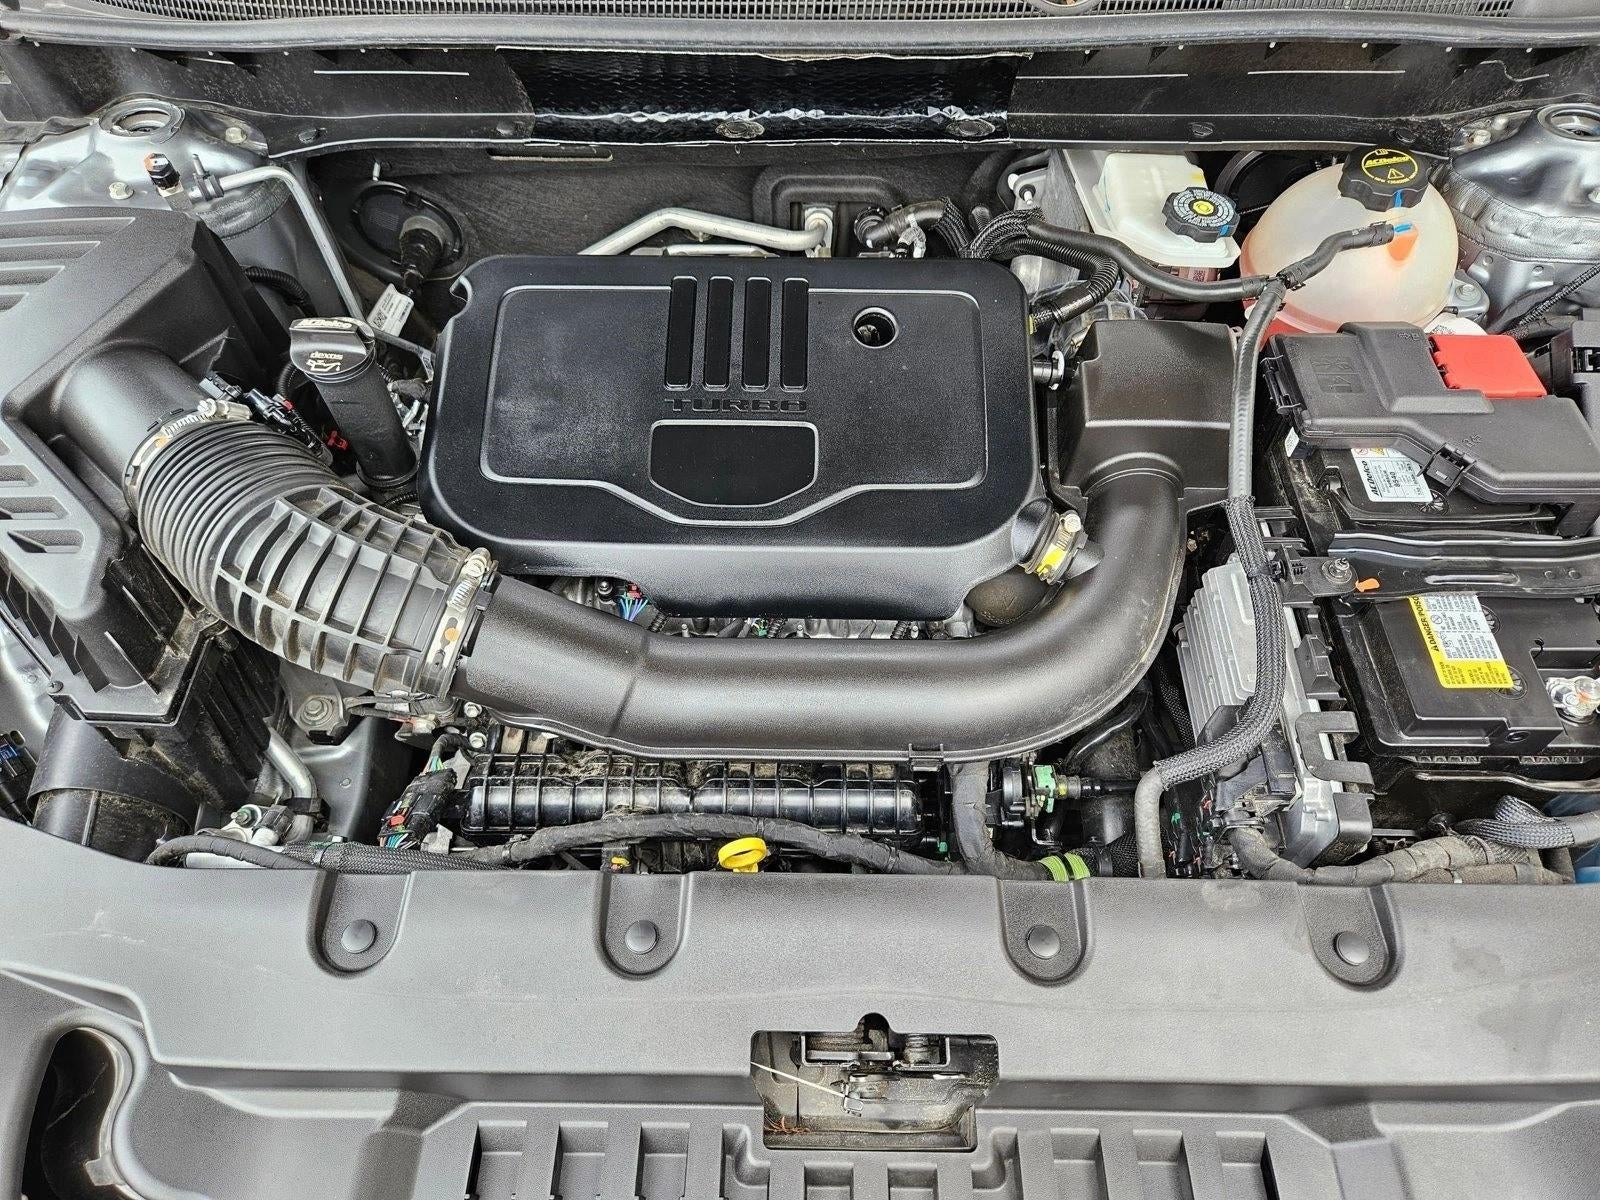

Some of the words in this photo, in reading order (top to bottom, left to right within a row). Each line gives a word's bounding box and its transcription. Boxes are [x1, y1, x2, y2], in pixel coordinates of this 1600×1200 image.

[310, 351, 343, 360] dexos
[664, 399, 807, 412] TURBO
[1361, 460, 1379, 496] ACDelco
